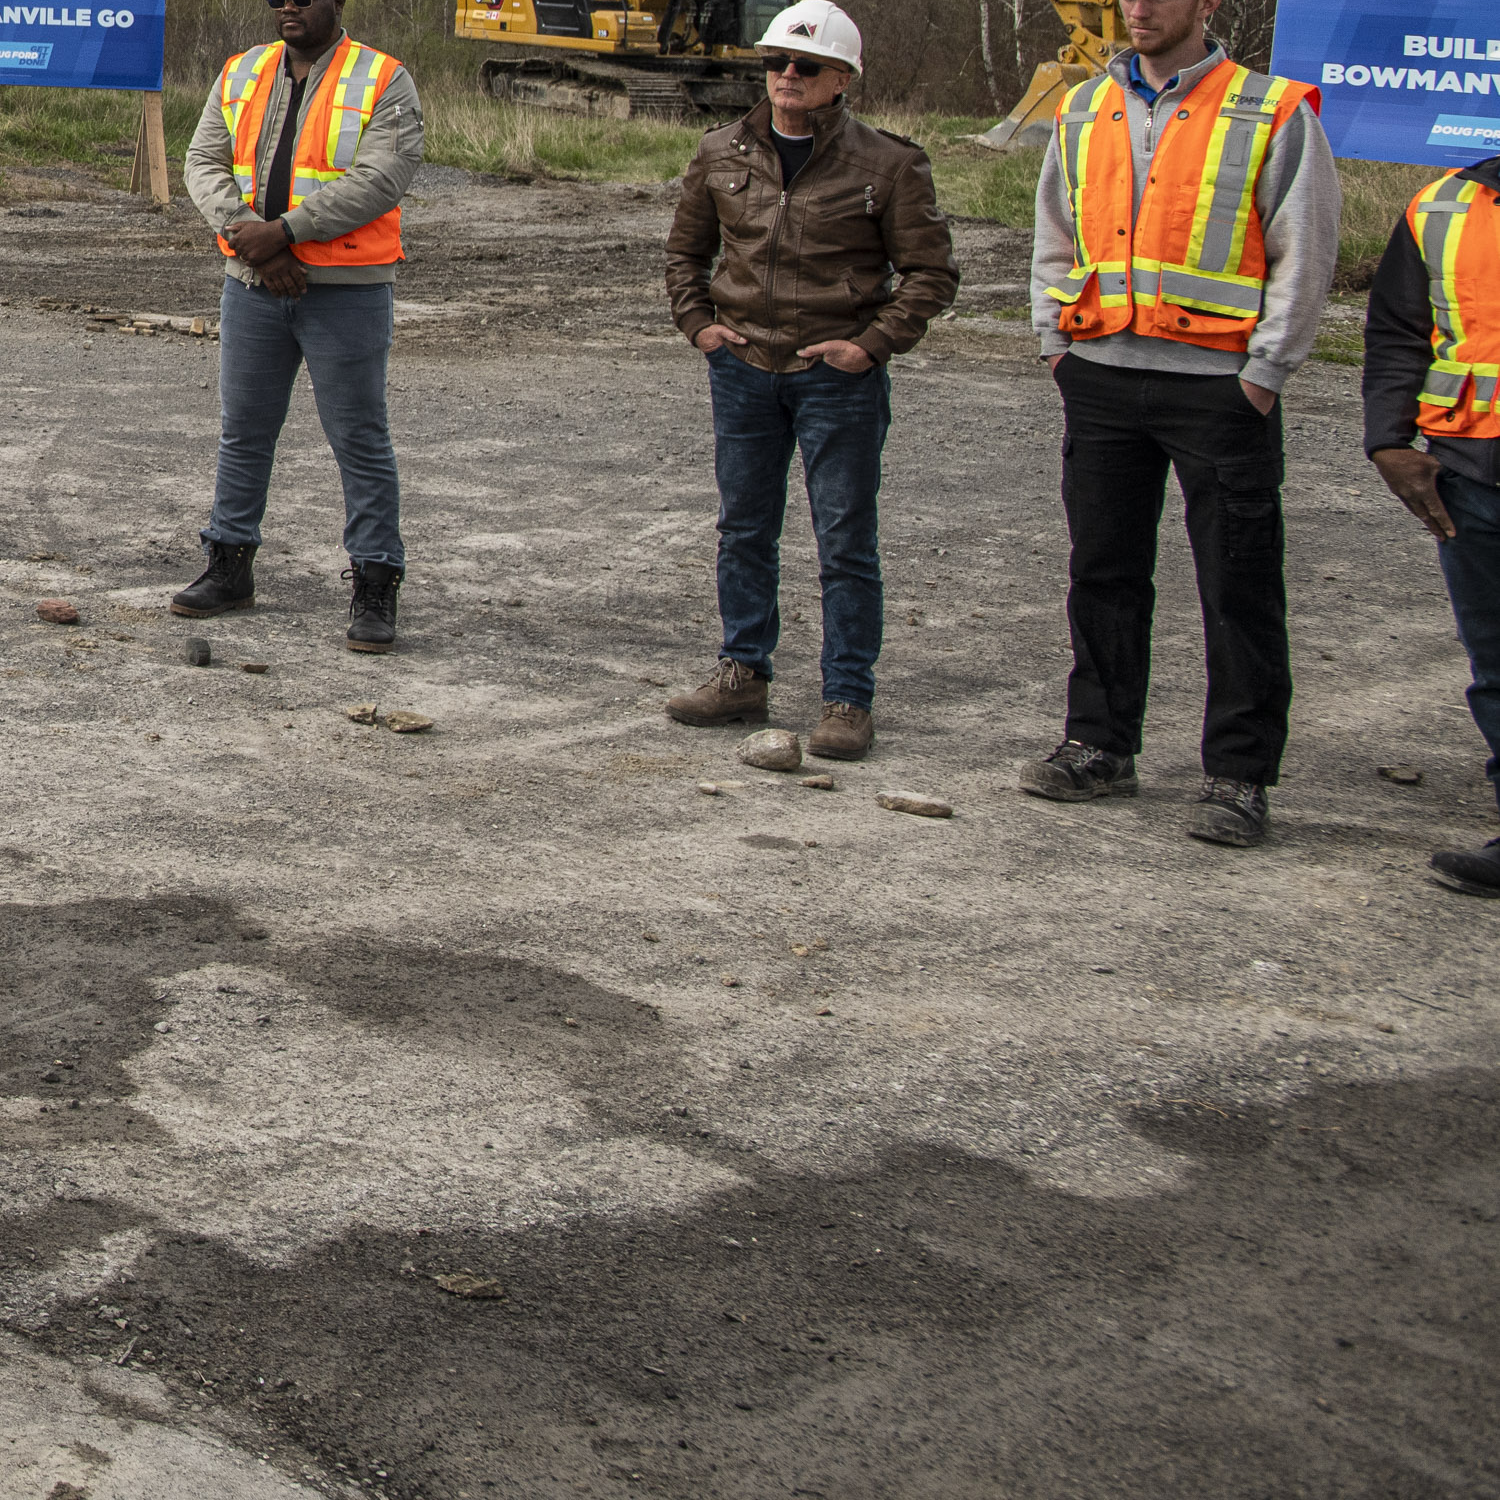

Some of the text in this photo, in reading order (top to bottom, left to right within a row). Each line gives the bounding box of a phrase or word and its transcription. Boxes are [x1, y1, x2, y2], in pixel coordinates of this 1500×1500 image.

[97, 9, 135, 28] GO
[12, 51, 38, 59] FORD
[1431, 124, 1473, 136] DOUG
